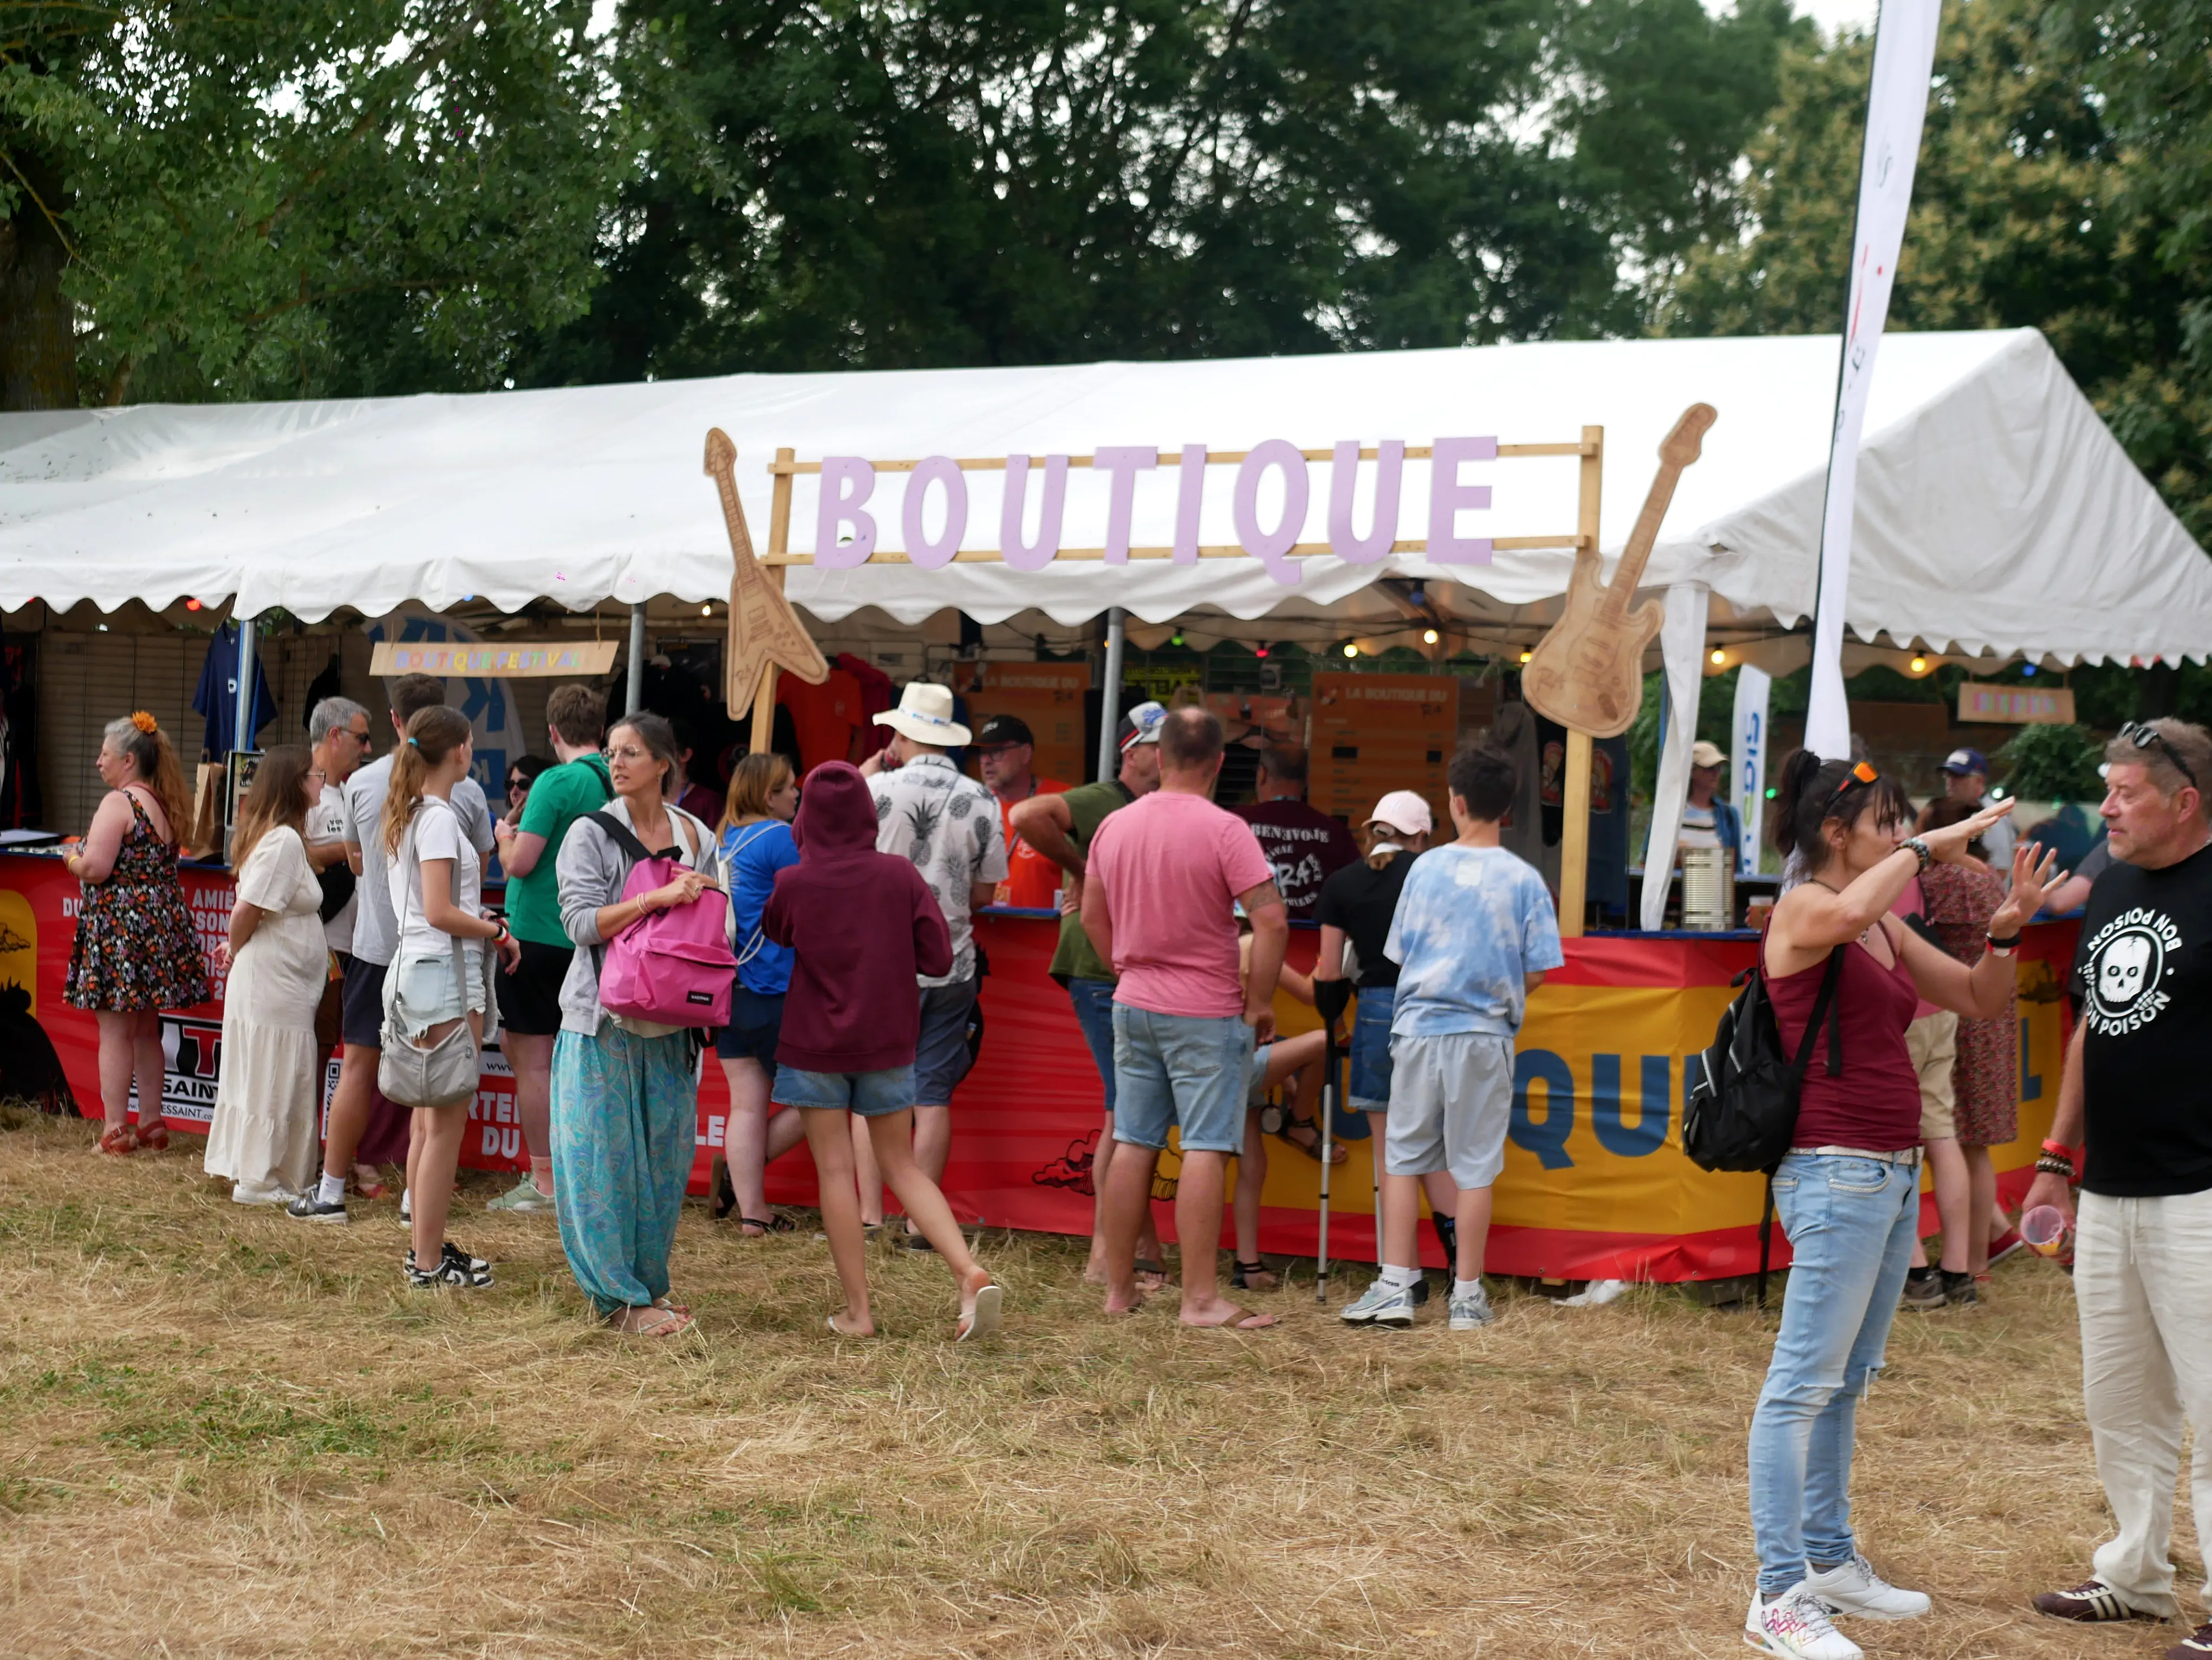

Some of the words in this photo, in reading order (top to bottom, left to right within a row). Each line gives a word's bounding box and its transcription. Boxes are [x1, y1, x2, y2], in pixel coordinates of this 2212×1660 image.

[814, 436, 1497, 586] BOUTIQUE
[395, 651, 493, 672] BOUTIQUE
[497, 651, 581, 670] FESTIVAL
[2087, 907, 2156, 951] POISON
[2152, 914, 2183, 952] BON
[2098, 990, 2171, 1036] POISON
[482, 1126, 520, 1159] DU
